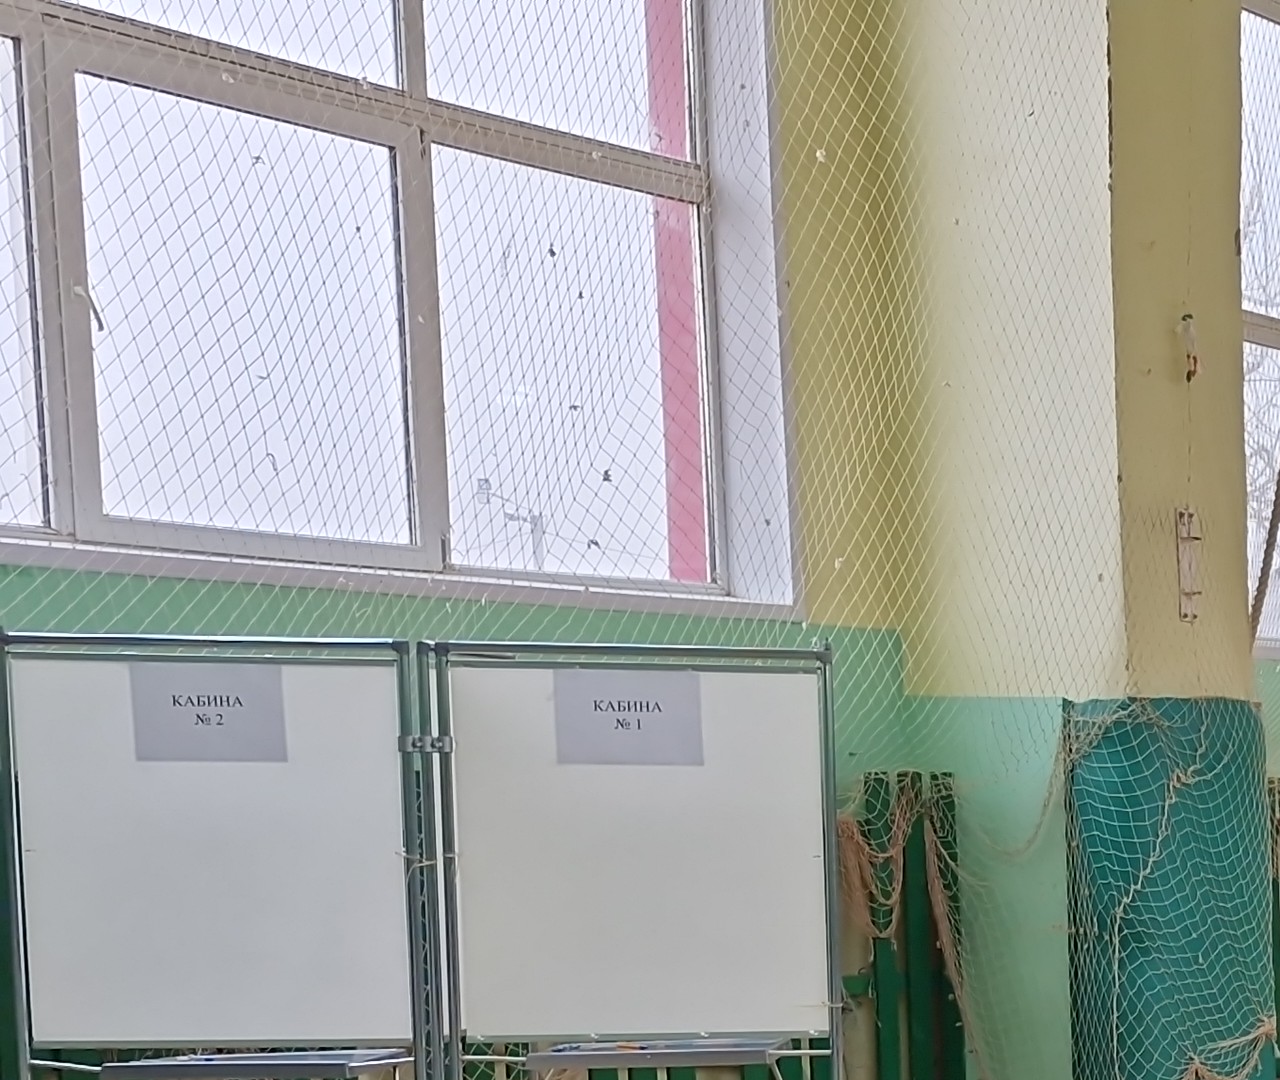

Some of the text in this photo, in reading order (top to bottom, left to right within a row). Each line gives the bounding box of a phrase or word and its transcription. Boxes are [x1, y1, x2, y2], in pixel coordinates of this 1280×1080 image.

[171, 694, 244, 707] КАБИНА
[593, 699, 662, 713] КАБИНА
[194, 713, 225, 726] № 2
[614, 718, 642, 731] № 1
